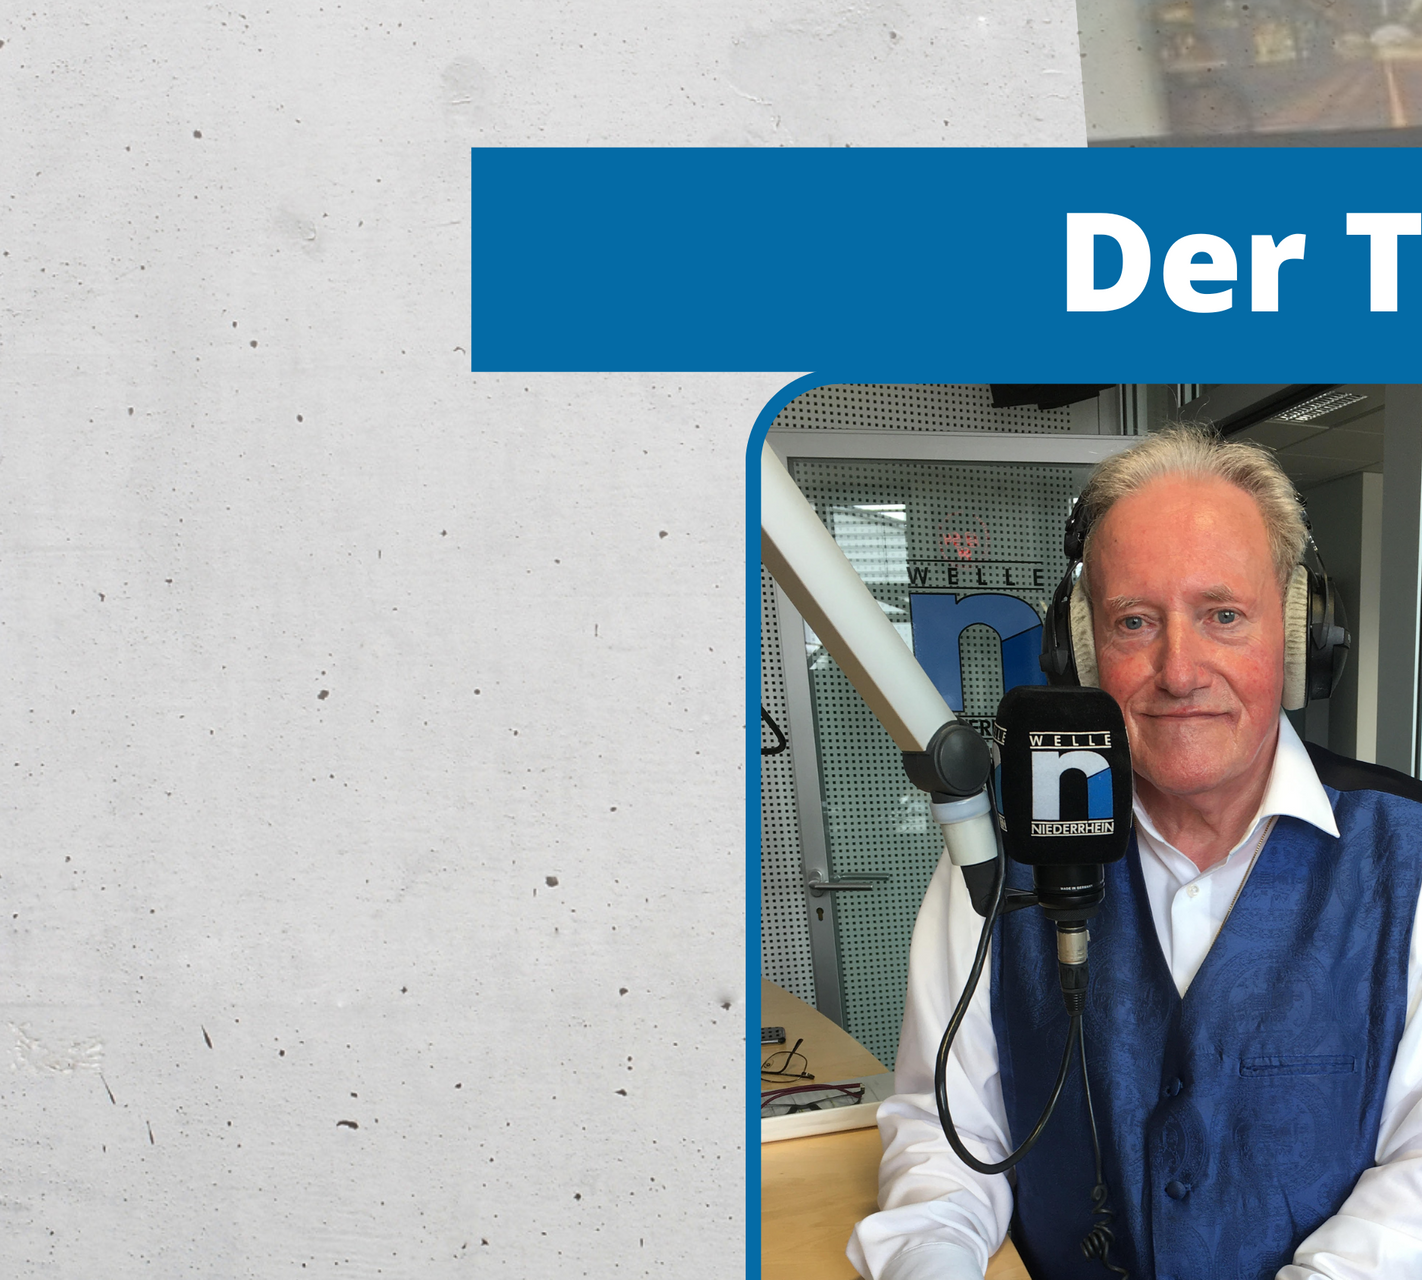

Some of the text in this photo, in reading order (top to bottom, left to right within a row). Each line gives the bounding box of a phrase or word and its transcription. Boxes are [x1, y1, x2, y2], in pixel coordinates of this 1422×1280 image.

[906, 567, 1045, 586] WELLE
[1029, 735, 1111, 746] WELLE
[1031, 822, 1114, 834] NIEDERRHEIN
